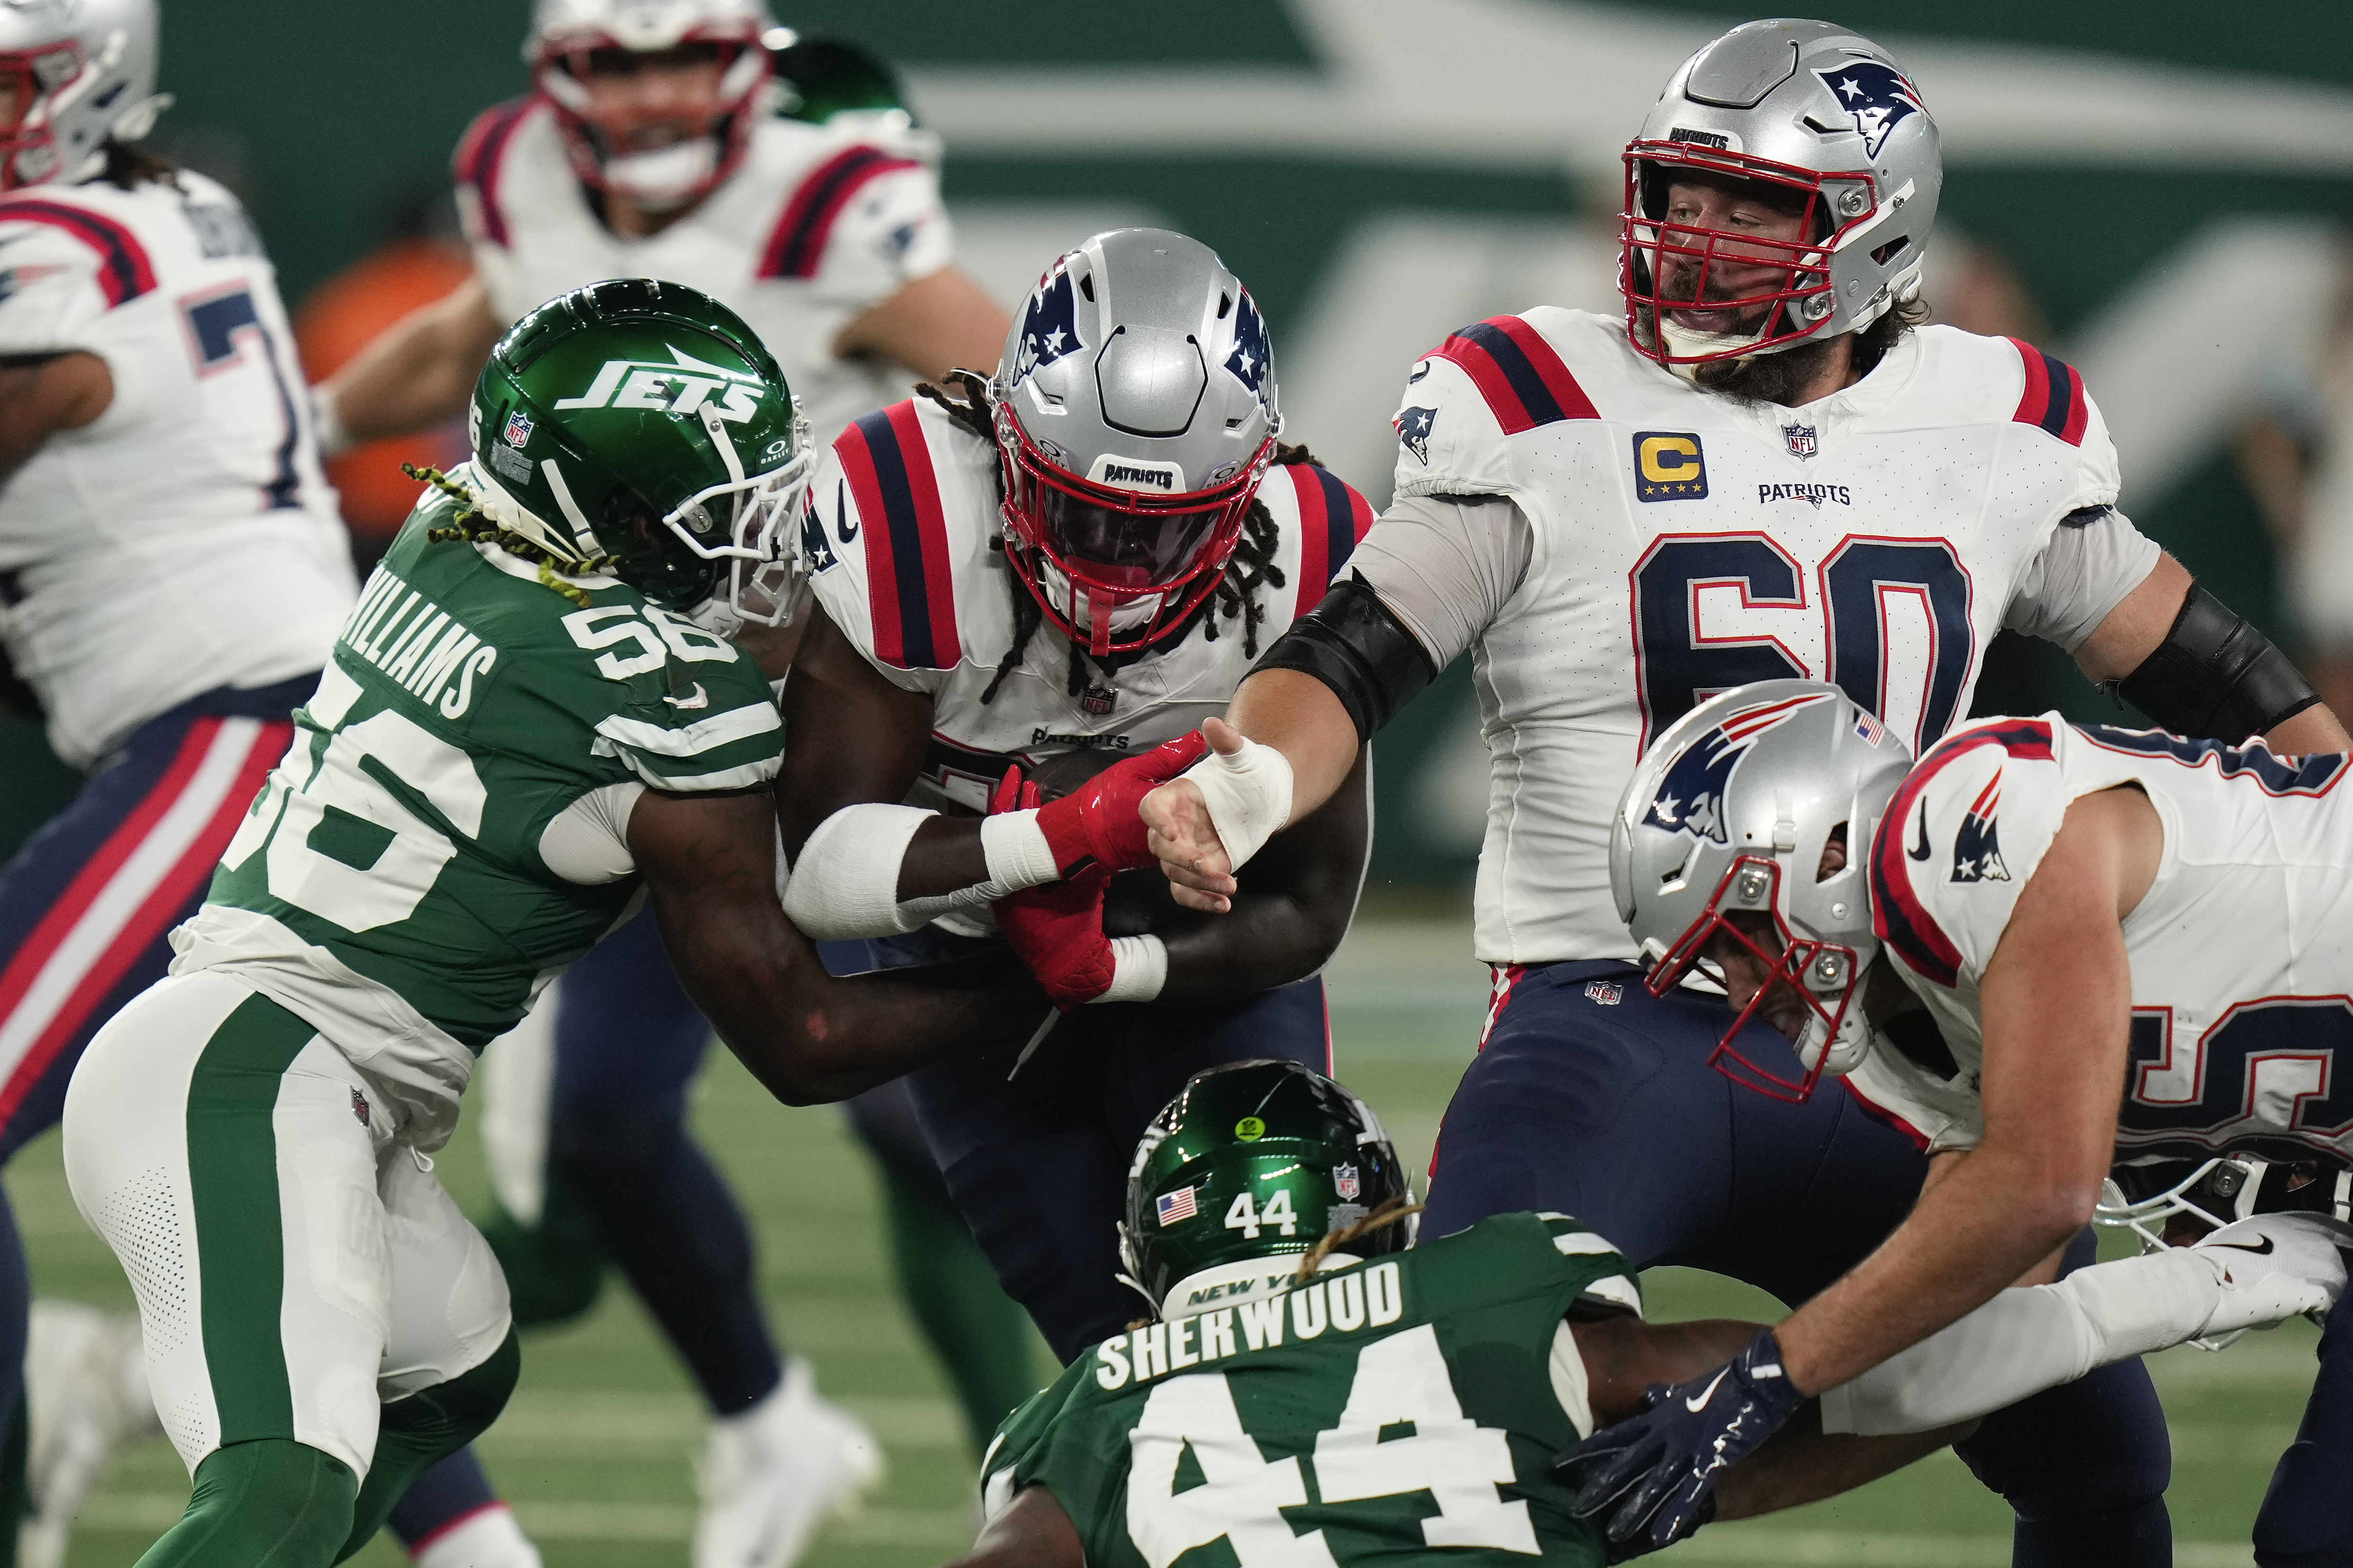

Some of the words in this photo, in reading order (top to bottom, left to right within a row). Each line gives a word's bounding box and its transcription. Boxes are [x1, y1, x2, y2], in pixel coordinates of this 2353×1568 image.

[1668, 127, 1729, 150] PATRIOTS
[554, 342, 765, 424] JETS
[508, 425, 525, 443] NFL
[1790, 437, 1814, 452] NFL
[761, 447, 790, 464] OAKLEY
[1640, 436, 1700, 483] C
[1104, 463, 1174, 490] PATRIOTS
[1759, 483, 1850, 506] PATRIOTS
[560, 605, 739, 680] 56
[1628, 530, 1975, 767] 60
[1085, 698, 1109, 712] NFL
[1591, 987, 1616, 1001] NFL
[1224, 1189, 1297, 1239] 44
[1187, 1279, 1255, 1307] NEW
[1095, 1262, 1403, 1391] SHERWOOD
[1126, 1323, 1543, 1568] 44
